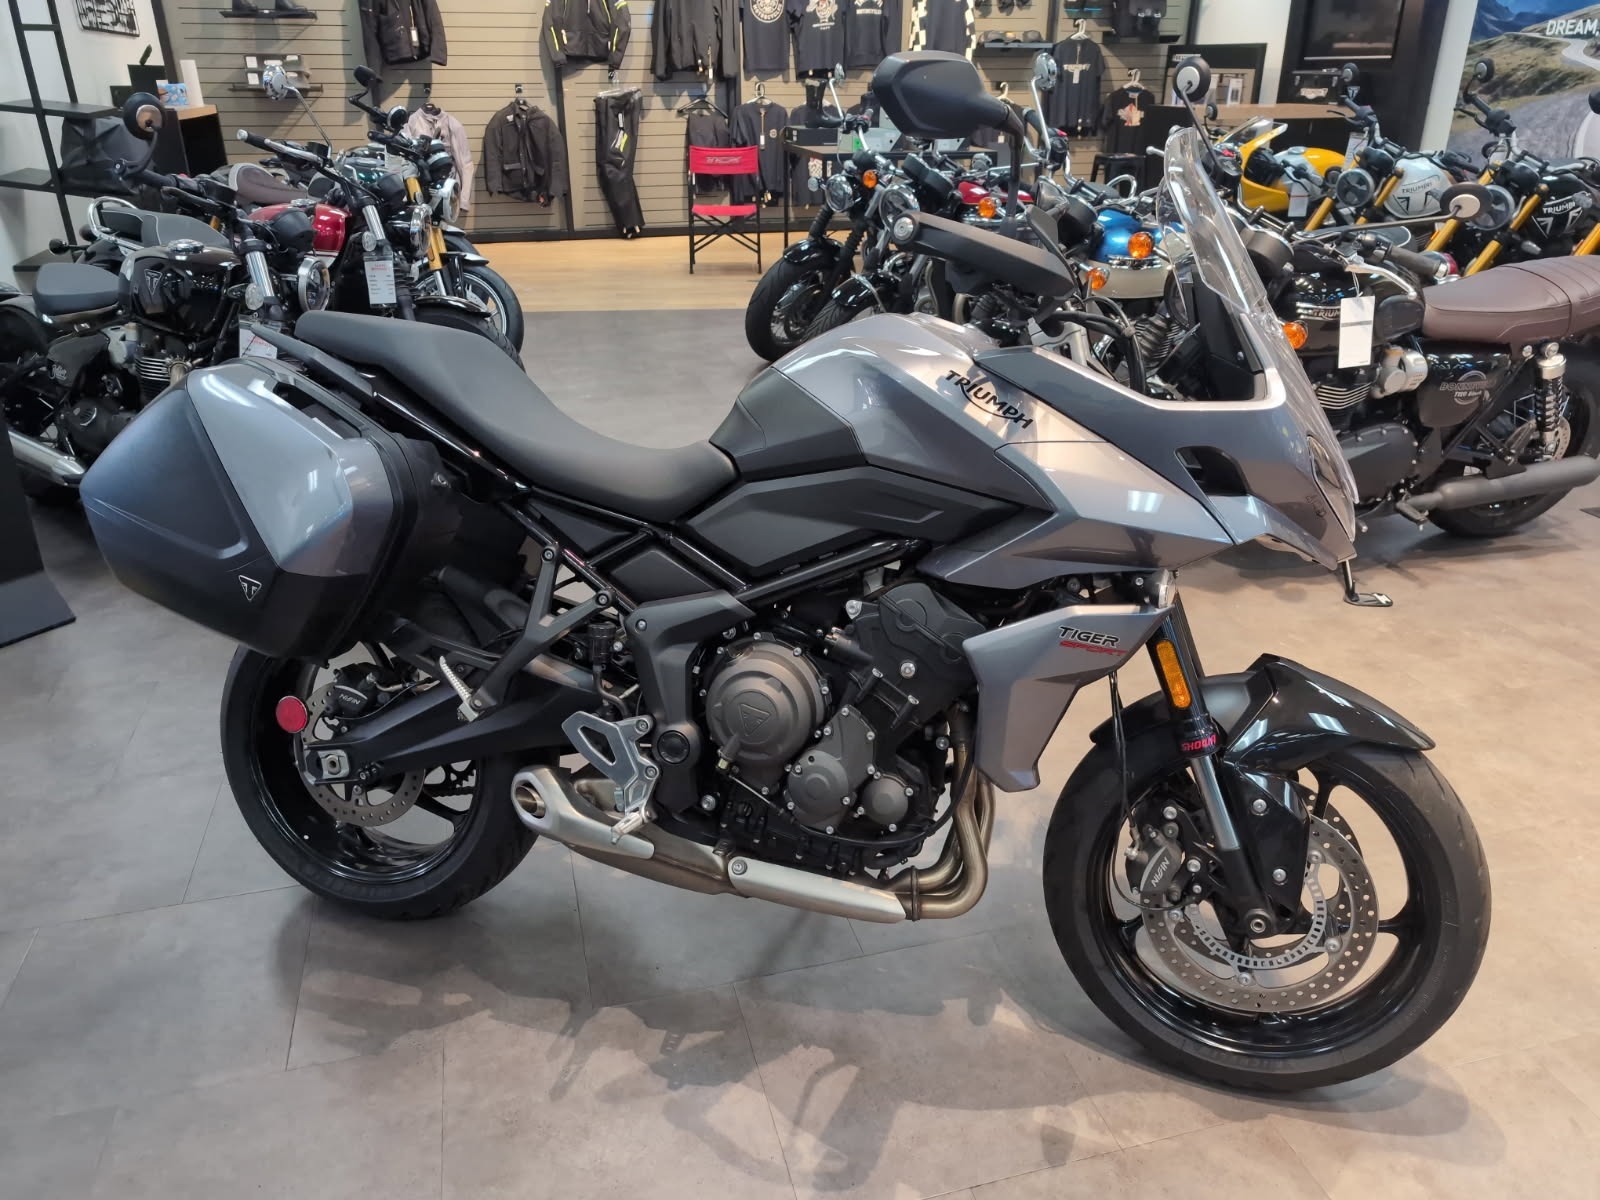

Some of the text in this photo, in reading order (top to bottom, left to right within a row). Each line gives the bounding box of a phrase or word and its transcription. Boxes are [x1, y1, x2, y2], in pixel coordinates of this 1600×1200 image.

[1546, 19, 1599, 36] DREAM,
[1313, 309, 1341, 320] TRIUM
[946, 370, 1033, 429] TRIUMPH
[1059, 625, 1120, 649] TIGER
[1181, 734, 1217, 751] SHOWA
